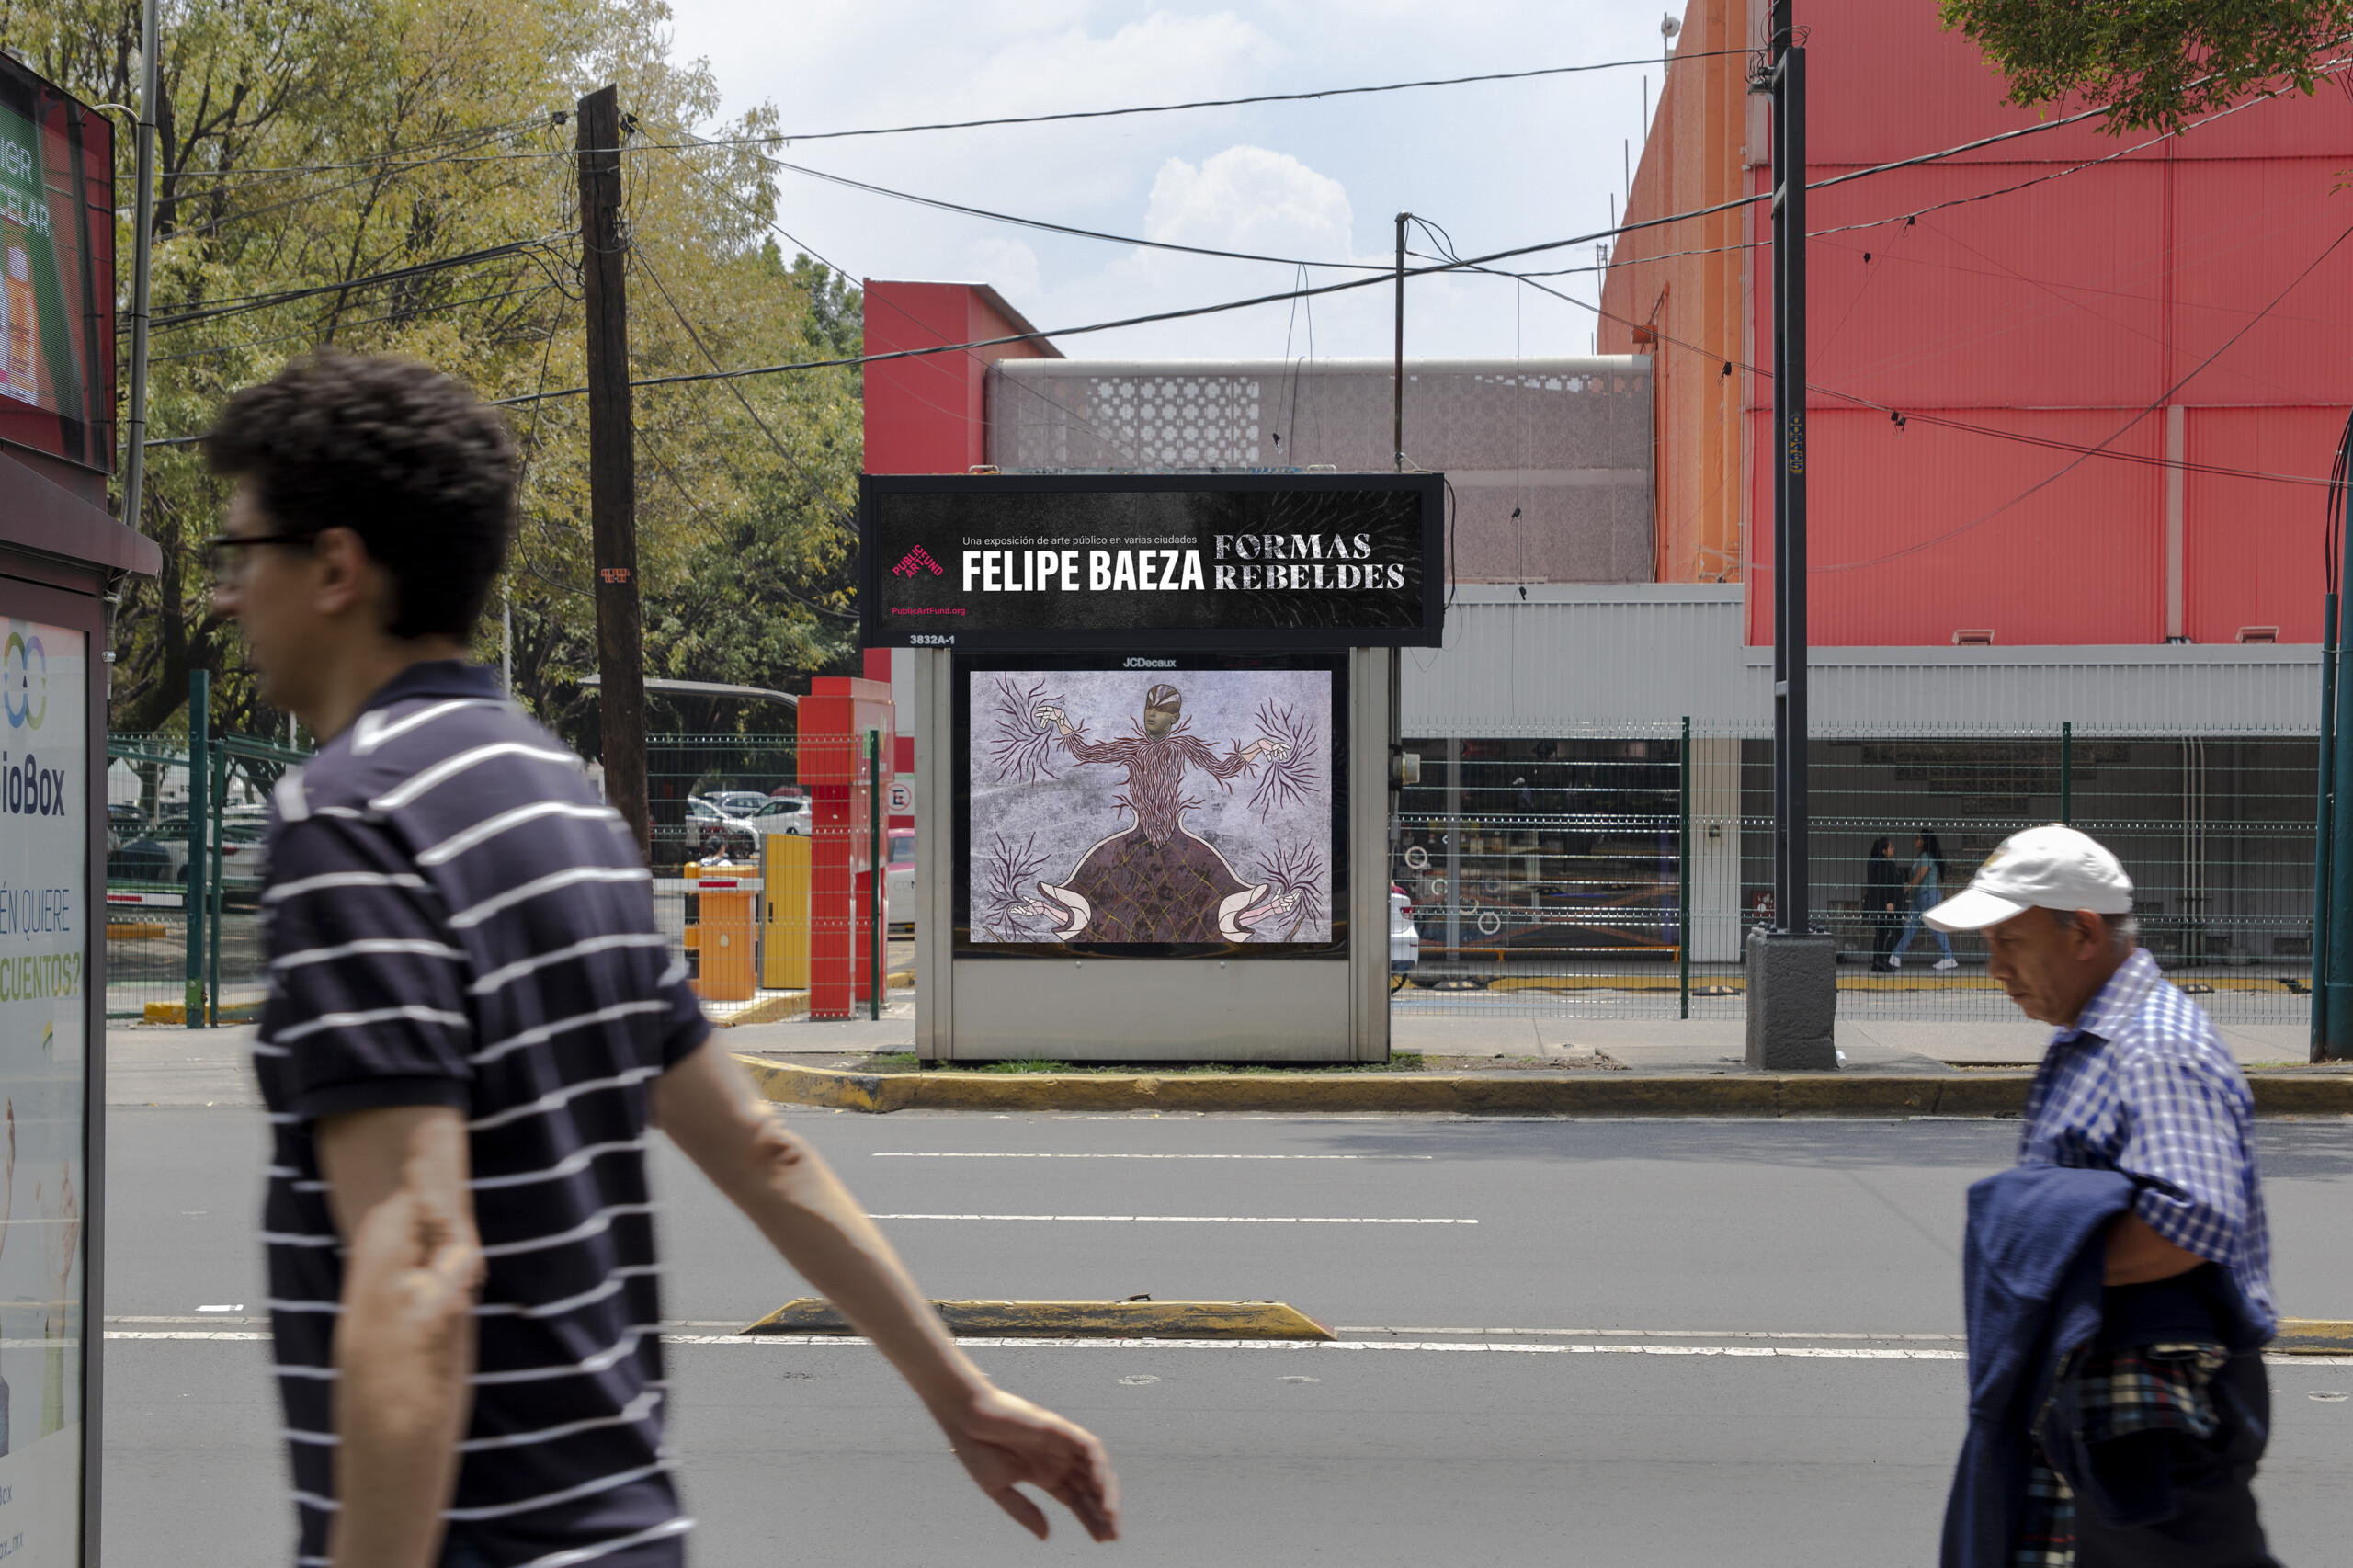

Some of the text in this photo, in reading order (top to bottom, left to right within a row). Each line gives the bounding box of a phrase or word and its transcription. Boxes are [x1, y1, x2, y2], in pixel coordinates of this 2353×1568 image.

[962, 535, 1198, 547] Una exposición de arte público en varias ciudades
[1213, 532, 1371, 560] FORMAS
[892, 544, 925, 576] PUBLIC
[905, 555, 925, 579] ART
[921, 551, 944, 576] FUND
[962, 549, 1205, 592] FELIPE BAEZA
[1213, 563, 1405, 590] REBELDES
[892, 607, 966, 617] PublicArtFund.org
[909, 634, 955, 645] 3832A-1
[1122, 656, 1176, 668] JCDecaux
[0, 750, 65, 816] ioBox
[892, 789, 904, 806] E
[22, 889, 70, 941] QUIERE
[0, 951, 81, 1003] CUENTOS?
